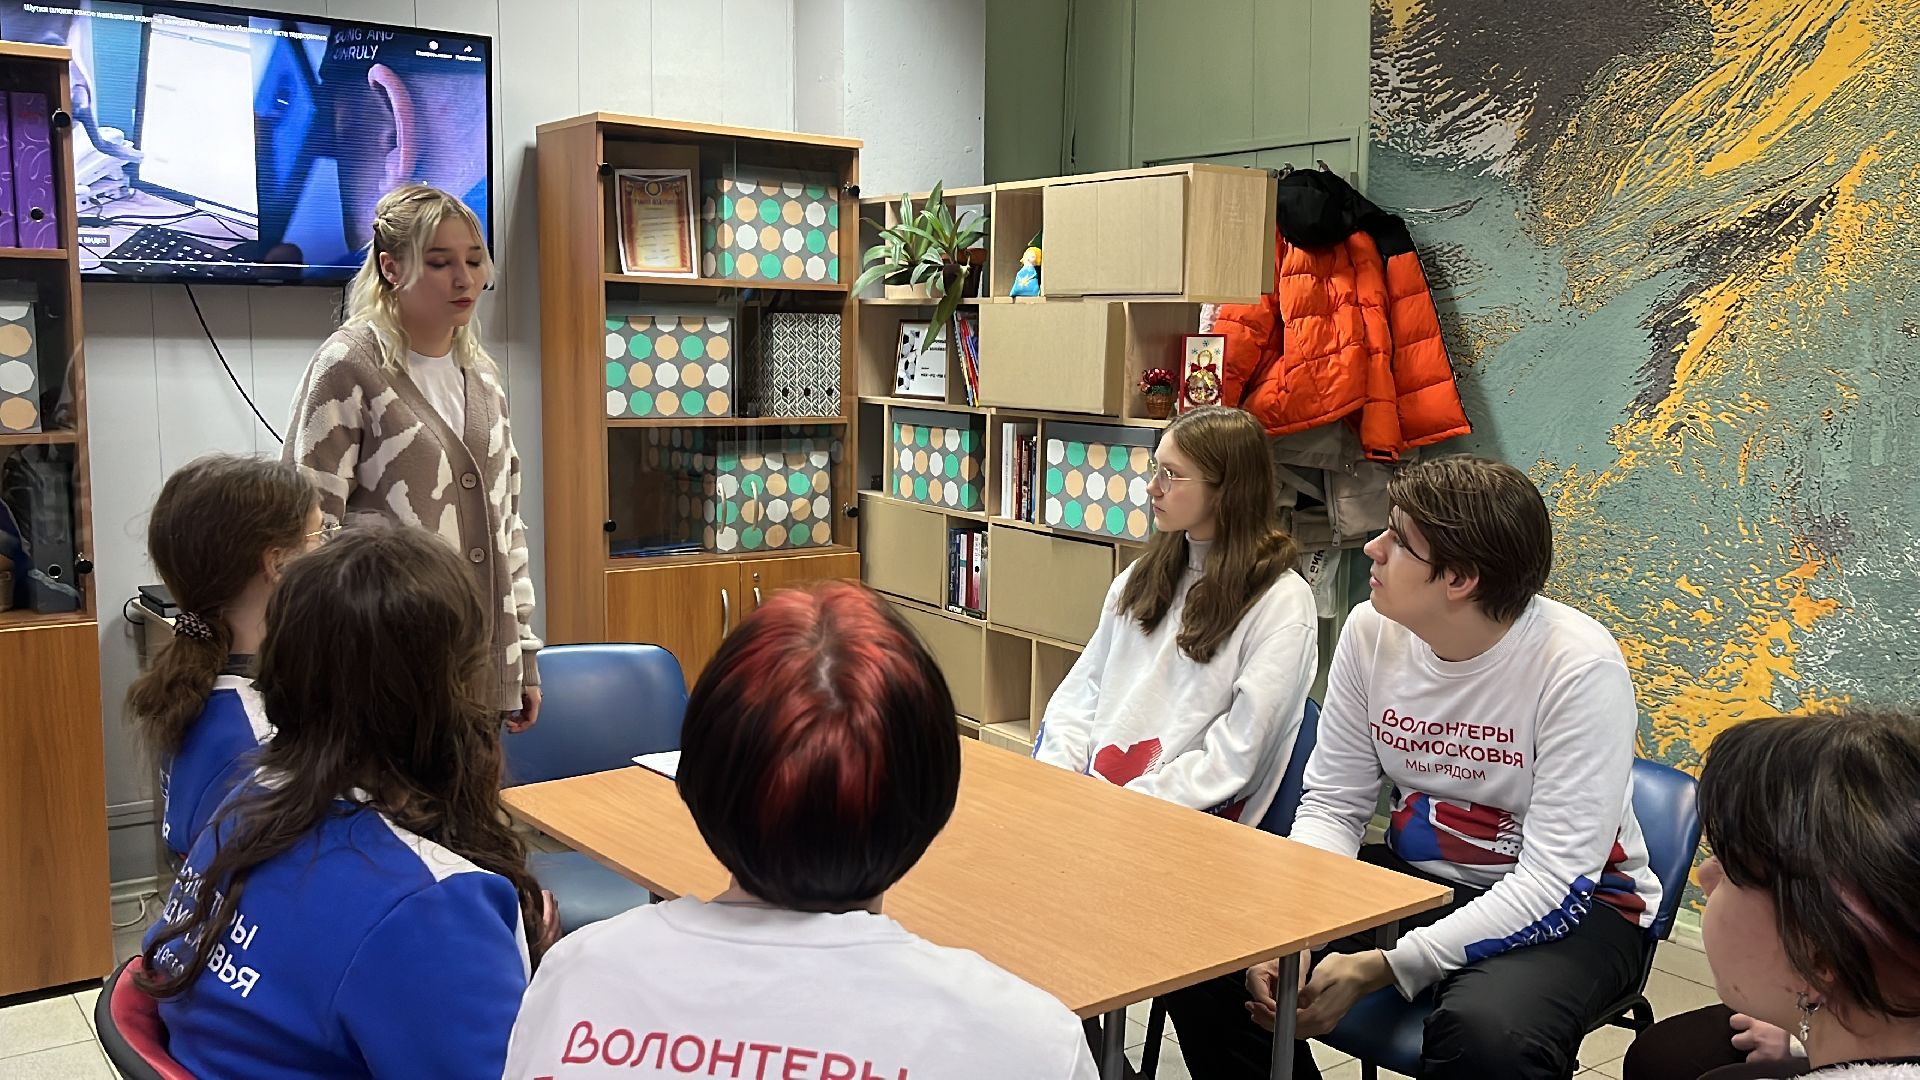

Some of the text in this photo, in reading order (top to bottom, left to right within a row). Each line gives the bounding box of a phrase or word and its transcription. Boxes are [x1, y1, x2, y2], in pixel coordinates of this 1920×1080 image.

[1382, 708, 1514, 743] ВОЛОНТЕРЫ
[1370, 721, 1524, 768] ПОДМОСКОВЬЯ
[1405, 758, 1486, 781] МЫ РЯДОМ
